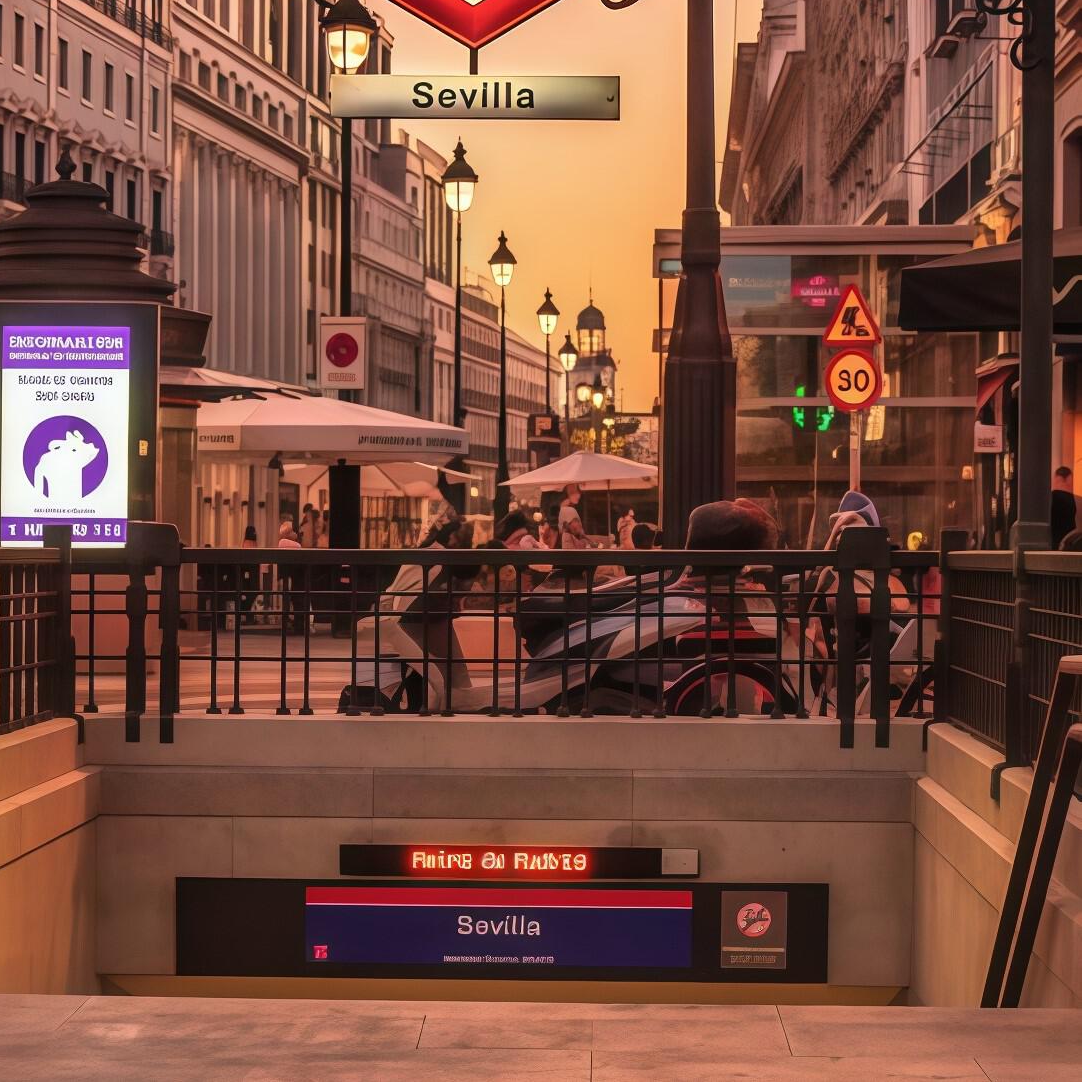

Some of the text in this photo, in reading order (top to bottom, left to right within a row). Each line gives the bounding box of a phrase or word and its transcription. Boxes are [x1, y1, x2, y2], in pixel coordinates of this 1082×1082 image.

[411, 81, 536, 110] Sevilla
[837, 369, 870, 392] 30
[457, 914, 541, 936] Sevilla
